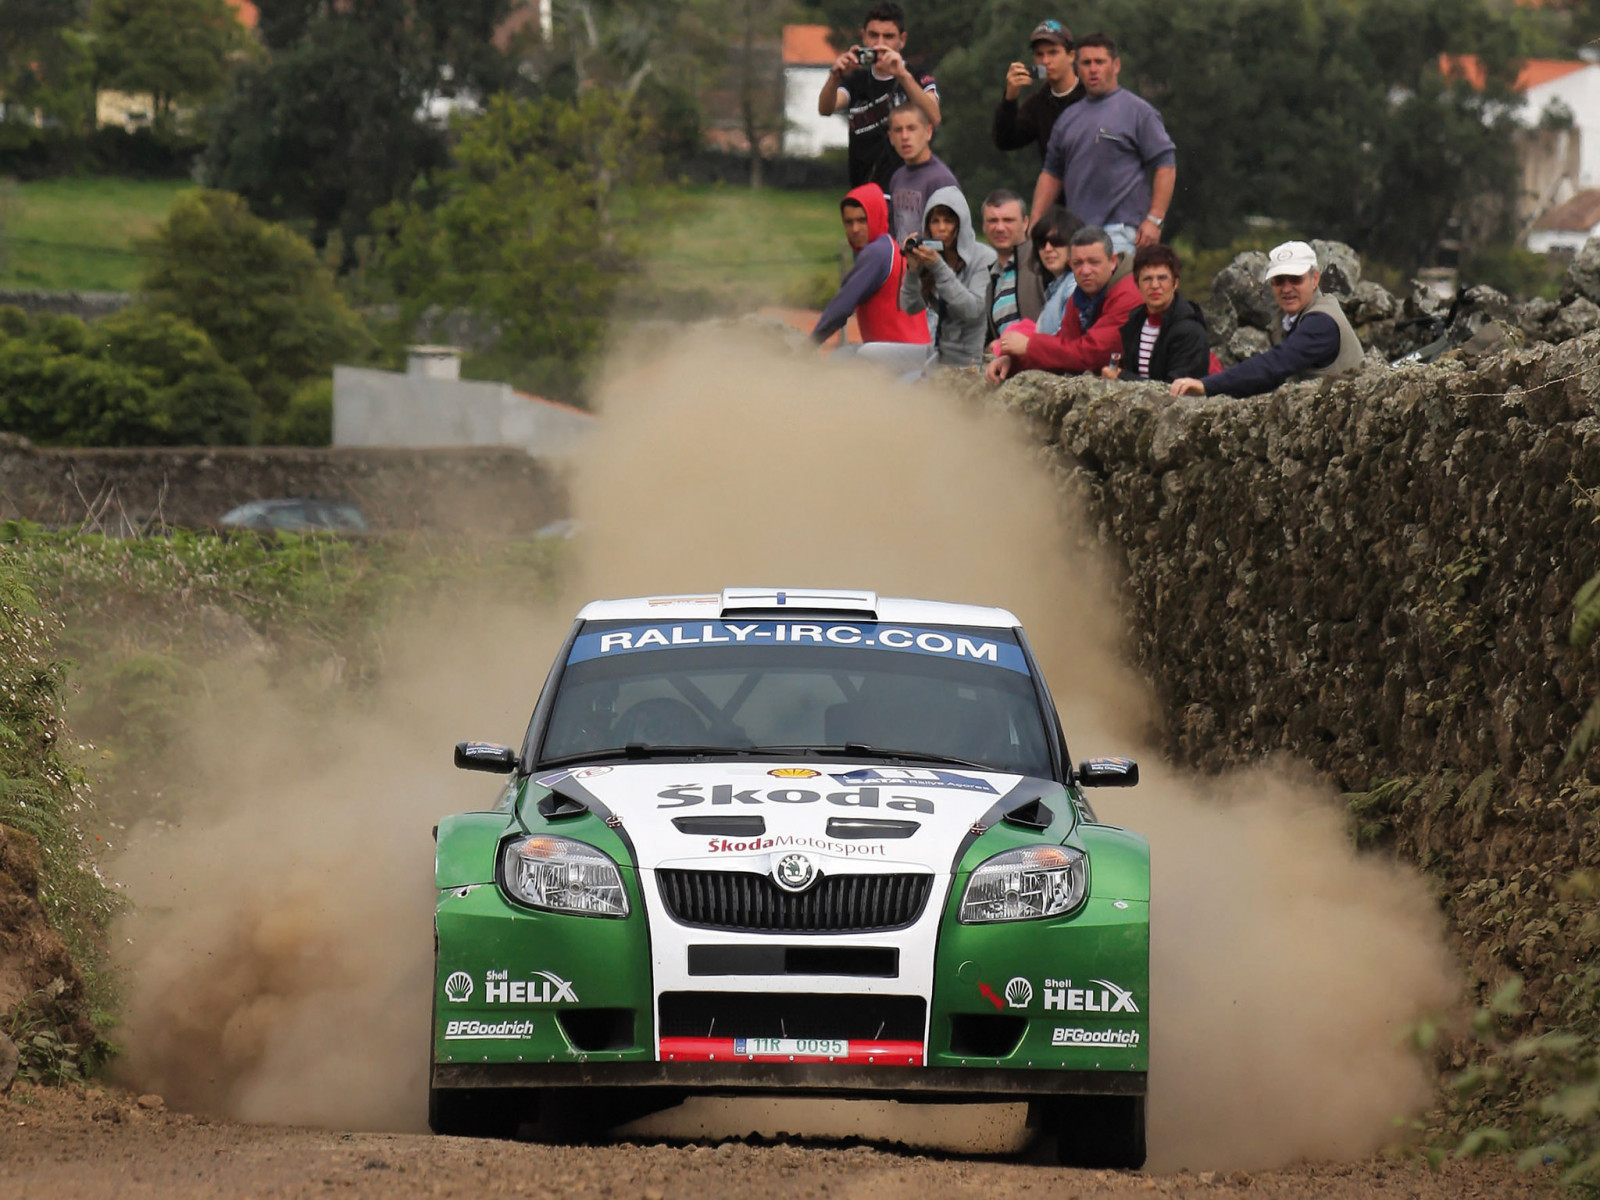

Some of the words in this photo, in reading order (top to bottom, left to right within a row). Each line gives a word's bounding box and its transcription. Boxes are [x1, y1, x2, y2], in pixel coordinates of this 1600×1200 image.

[600, 624, 998, 662] RALLY-IRC.COM
[657, 783, 935, 815] Škoda
[486, 969, 508, 981] Shell
[485, 970, 579, 1003] HELIX
[1044, 979, 1072, 988] Shell
[1043, 979, 1140, 1013] HELIX
[446, 1020, 534, 1035] BFGoodrich
[1052, 1027, 1140, 1043] BFGoodrich
[753, 1038, 781, 1053] 11R
[796, 1039, 842, 1054] 0095
